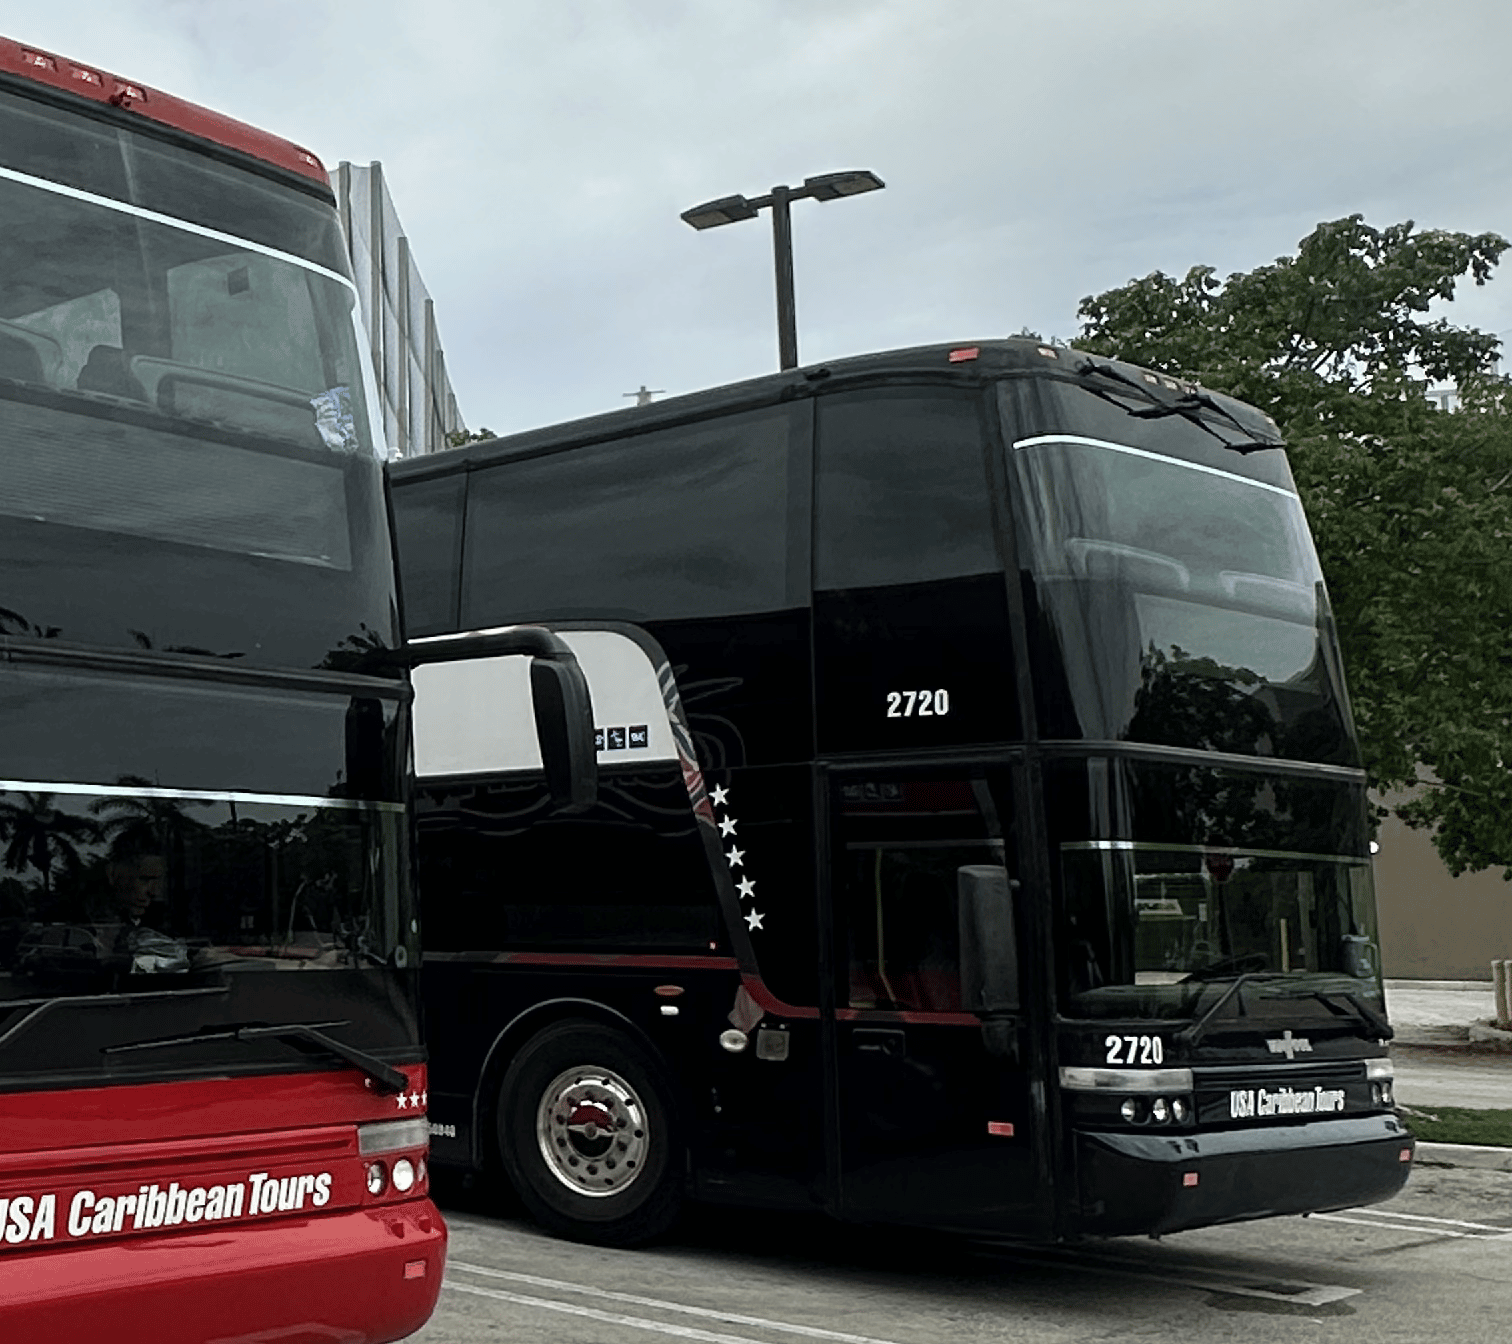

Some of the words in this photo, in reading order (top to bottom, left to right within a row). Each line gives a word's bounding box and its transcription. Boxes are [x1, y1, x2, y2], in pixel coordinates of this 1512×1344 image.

[886, 688, 949, 718] 2720
[1105, 1035, 1163, 1064] 2720
[1230, 1090, 1255, 1118] USA
[68, 1182, 245, 1237] Caribbean
[249, 1172, 332, 1215] Tours
